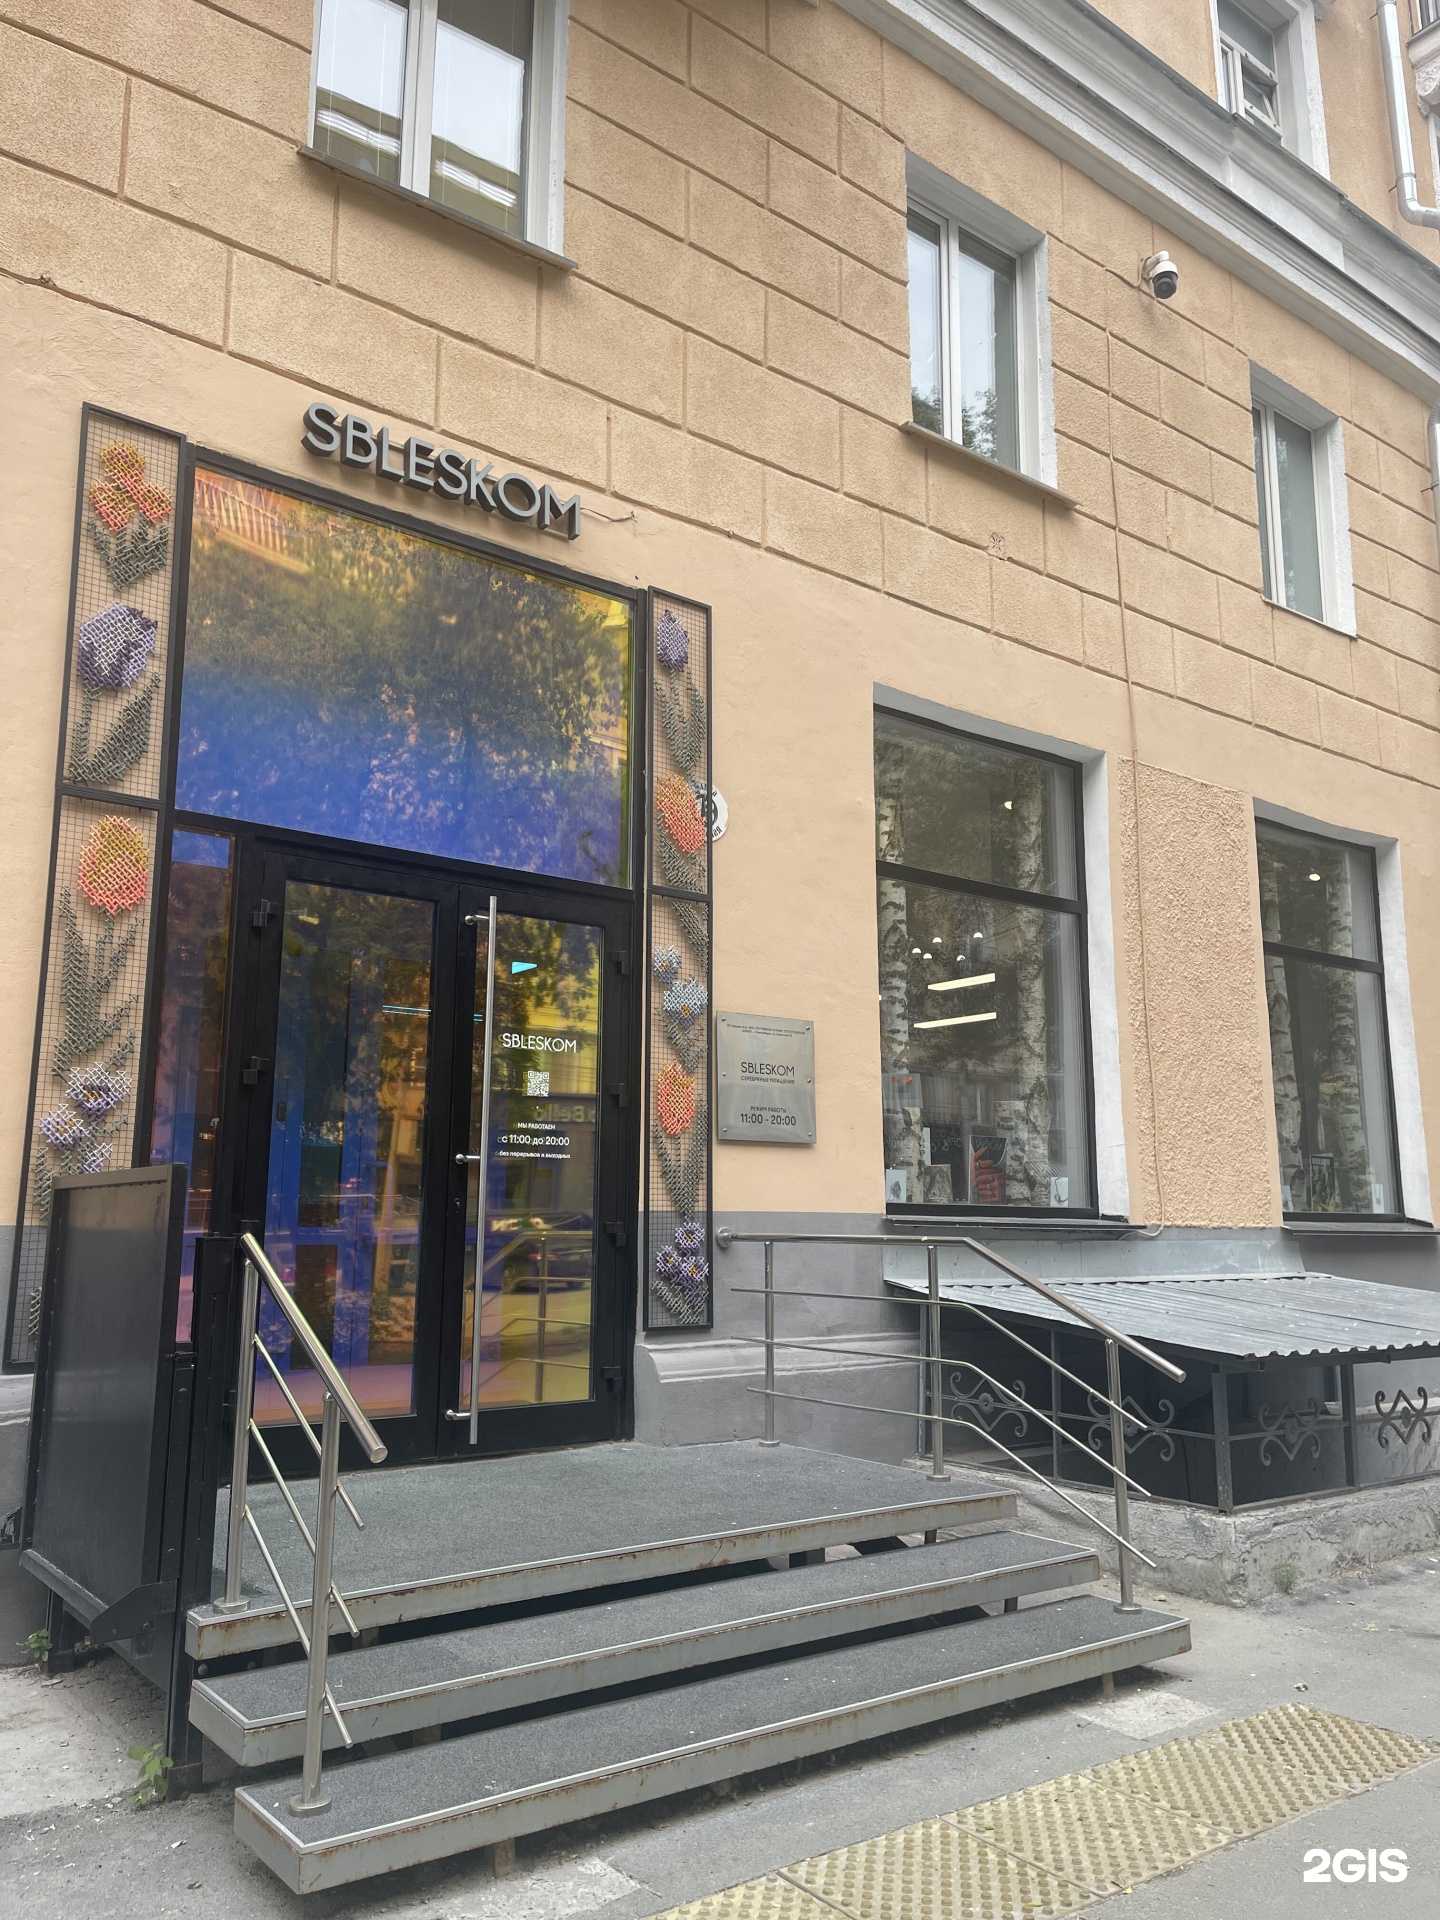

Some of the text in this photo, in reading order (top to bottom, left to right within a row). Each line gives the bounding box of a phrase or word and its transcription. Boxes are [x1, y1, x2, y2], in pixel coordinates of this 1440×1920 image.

[301, 402, 581, 541] SBLESKOM
[502, 1032, 577, 1053] SBLESKOM
[740, 1061, 795, 1078] SBLESKOM
[740, 1112, 763, 1124] 11:00
[770, 1114, 797, 1126] 20:00
[509, 1134, 531, 1144] 11:00
[532, 1138, 544, 1147] до
[545, 1136, 570, 1146] 20:00
